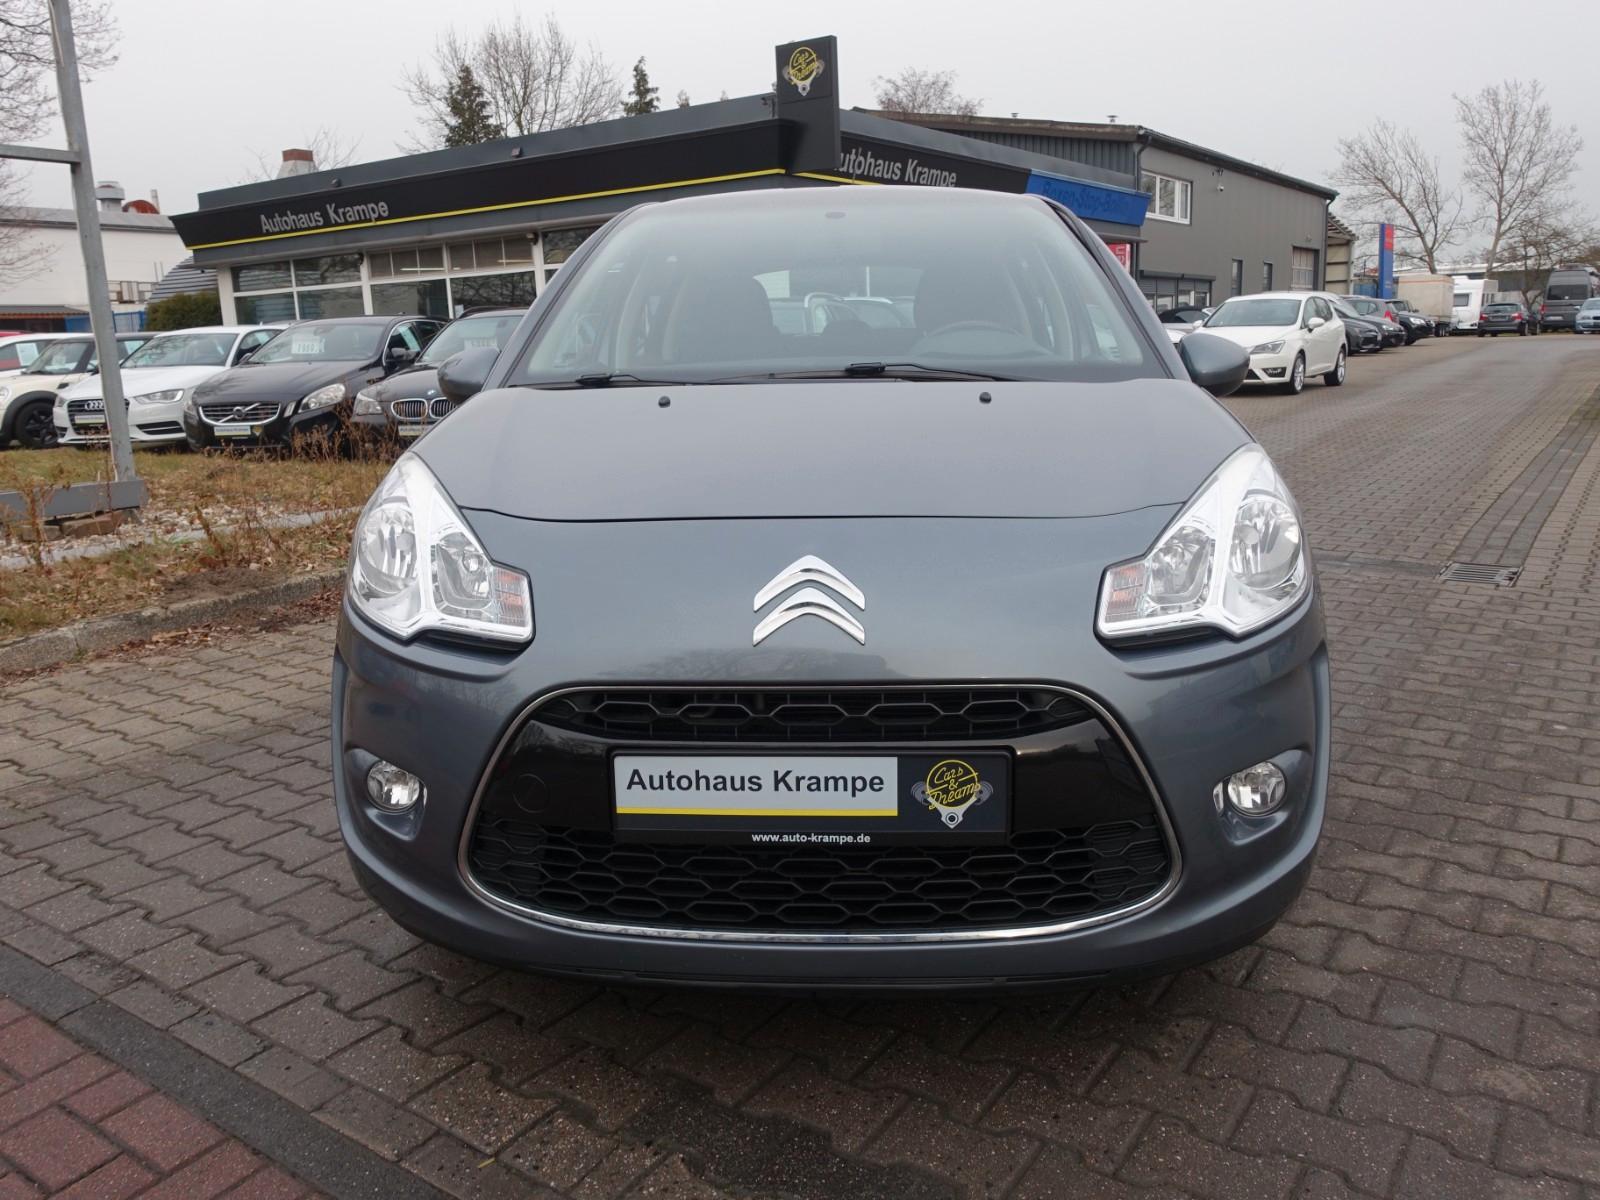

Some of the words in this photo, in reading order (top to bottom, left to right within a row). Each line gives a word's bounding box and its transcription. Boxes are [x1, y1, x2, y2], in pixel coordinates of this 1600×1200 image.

[834, 148, 902, 180] utohaus
[904, 158, 957, 187] Krampe
[260, 210, 324, 234] Autohaus
[326, 201, 389, 225] Krampe
[626, 768, 763, 793] Autohaus
[773, 769, 885, 798] Krampe
[934, 766, 964, 784] Cars
[948, 778, 959, 791] &
[929, 782, 981, 811] Dreams
[751, 832, 871, 845] www.auto-krampe.de
